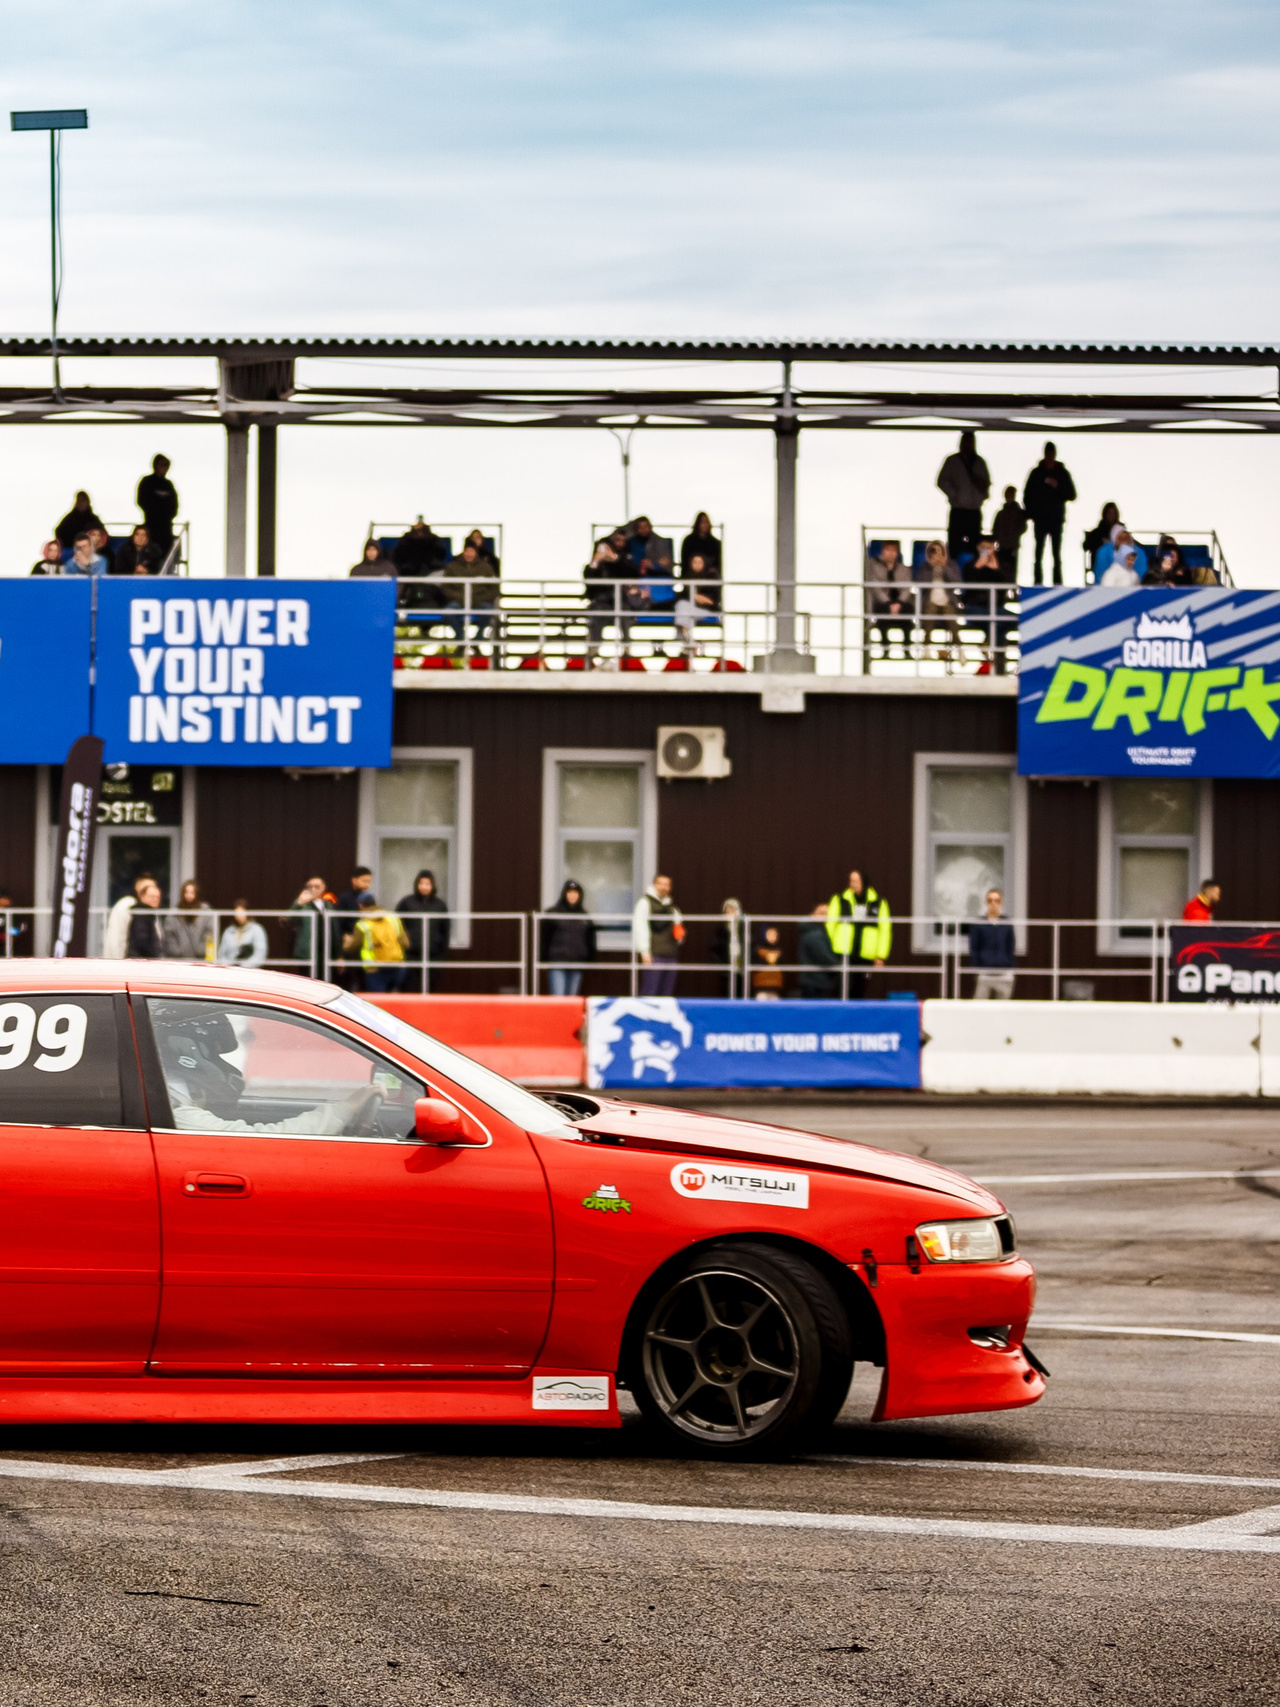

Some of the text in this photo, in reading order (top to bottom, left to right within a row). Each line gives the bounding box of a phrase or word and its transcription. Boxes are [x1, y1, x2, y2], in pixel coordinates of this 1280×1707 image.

[130, 599, 310, 646] POWER
[130, 647, 265, 694] YOUR
[1123, 640, 1207, 669] GORILLA
[1035, 659, 1280, 741] DRIFT
[129, 696, 362, 744] INSTINCT
[1205, 963, 1280, 994] Pan
[705, 1033, 900, 1052] POWER YOUR INSTINCT
[711, 1174, 796, 1192] MITSUJI
